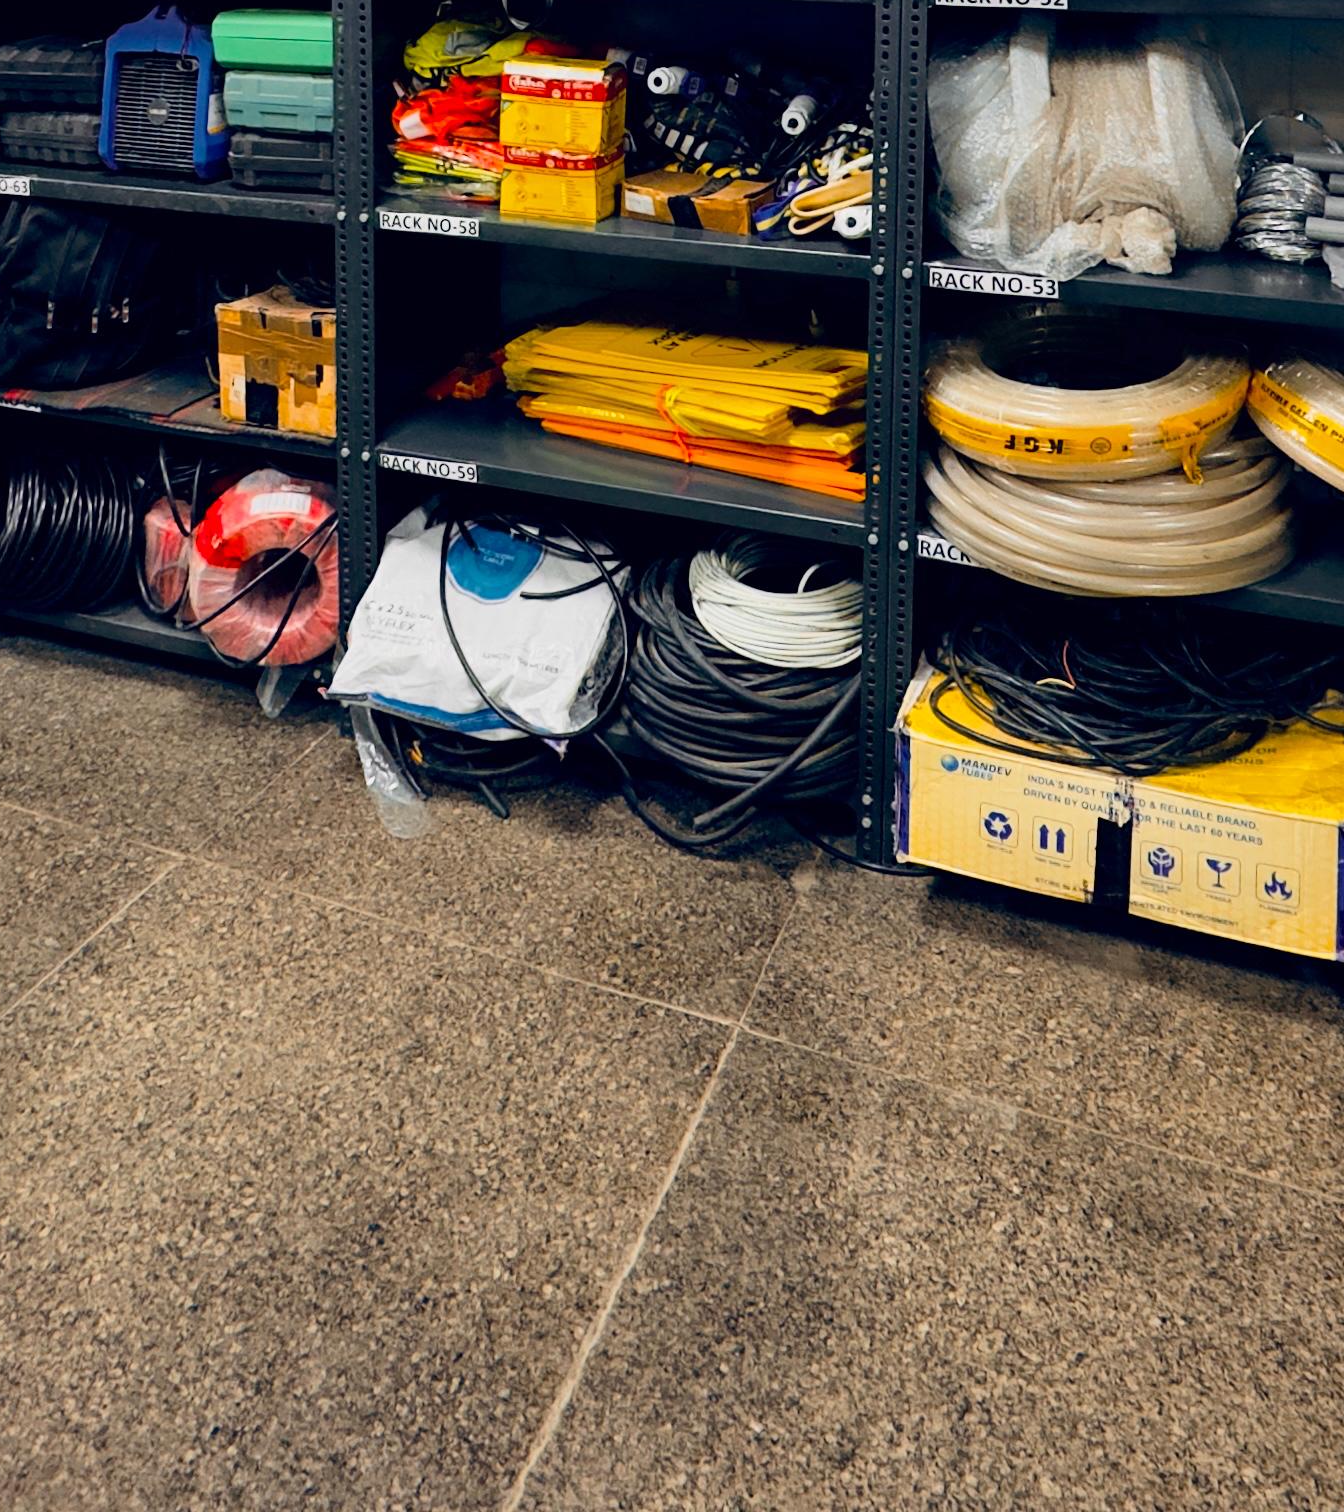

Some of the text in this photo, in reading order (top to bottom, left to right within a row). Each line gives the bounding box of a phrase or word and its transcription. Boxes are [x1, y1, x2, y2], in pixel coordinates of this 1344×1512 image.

[381, 212, 477, 236] RACK NO-58
[931, 271, 1056, 296] RACK NO-53
[1004, 434, 1064, 455] KGF
[381, 455, 476, 481] RACK NO-59
[961, 758, 1012, 777] MANDEV
[961, 768, 994, 782] TUBES
[1027, 775, 1065, 790] INDIA'S
[1067, 782, 1097, 797] MOST
[1160, 803, 1214, 822] RELIABLE
[1216, 814, 1259, 831] BRAND.
[1023, 788, 1062, 804] DRIVEN
[1065, 796, 1078, 807] BY
[1156, 816, 1176, 828] THE
[1179, 821, 1207, 834] LAST
[1210, 828, 1223, 838] 60
[1226, 831, 1264, 847] YEARS
